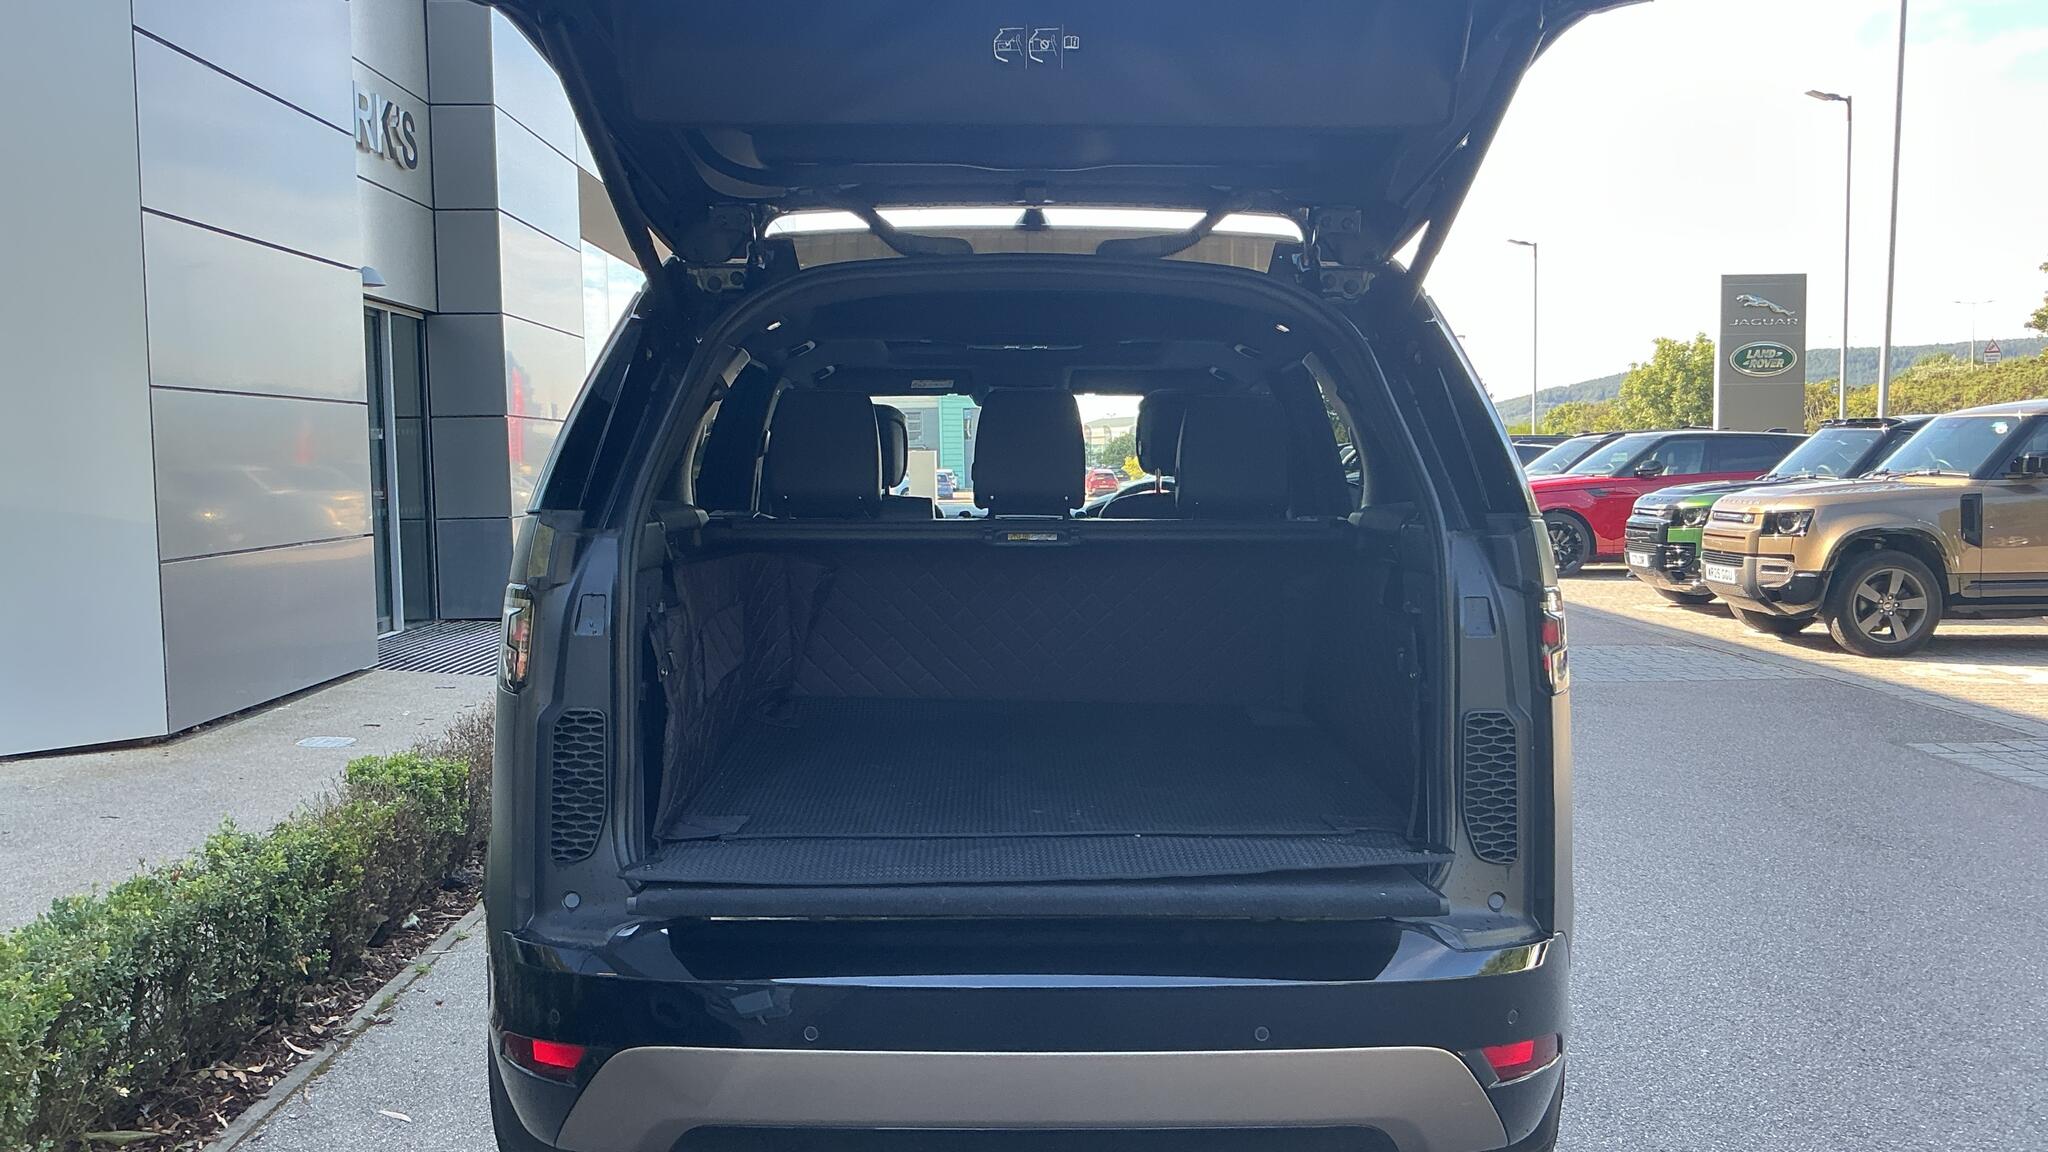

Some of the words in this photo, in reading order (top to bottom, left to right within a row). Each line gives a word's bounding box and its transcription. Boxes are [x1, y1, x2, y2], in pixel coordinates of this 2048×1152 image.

[1729, 318, 1798, 326] JAGUAR
[1746, 349, 1777, 359] LAND
[1748, 358, 1785, 368] ROVER
